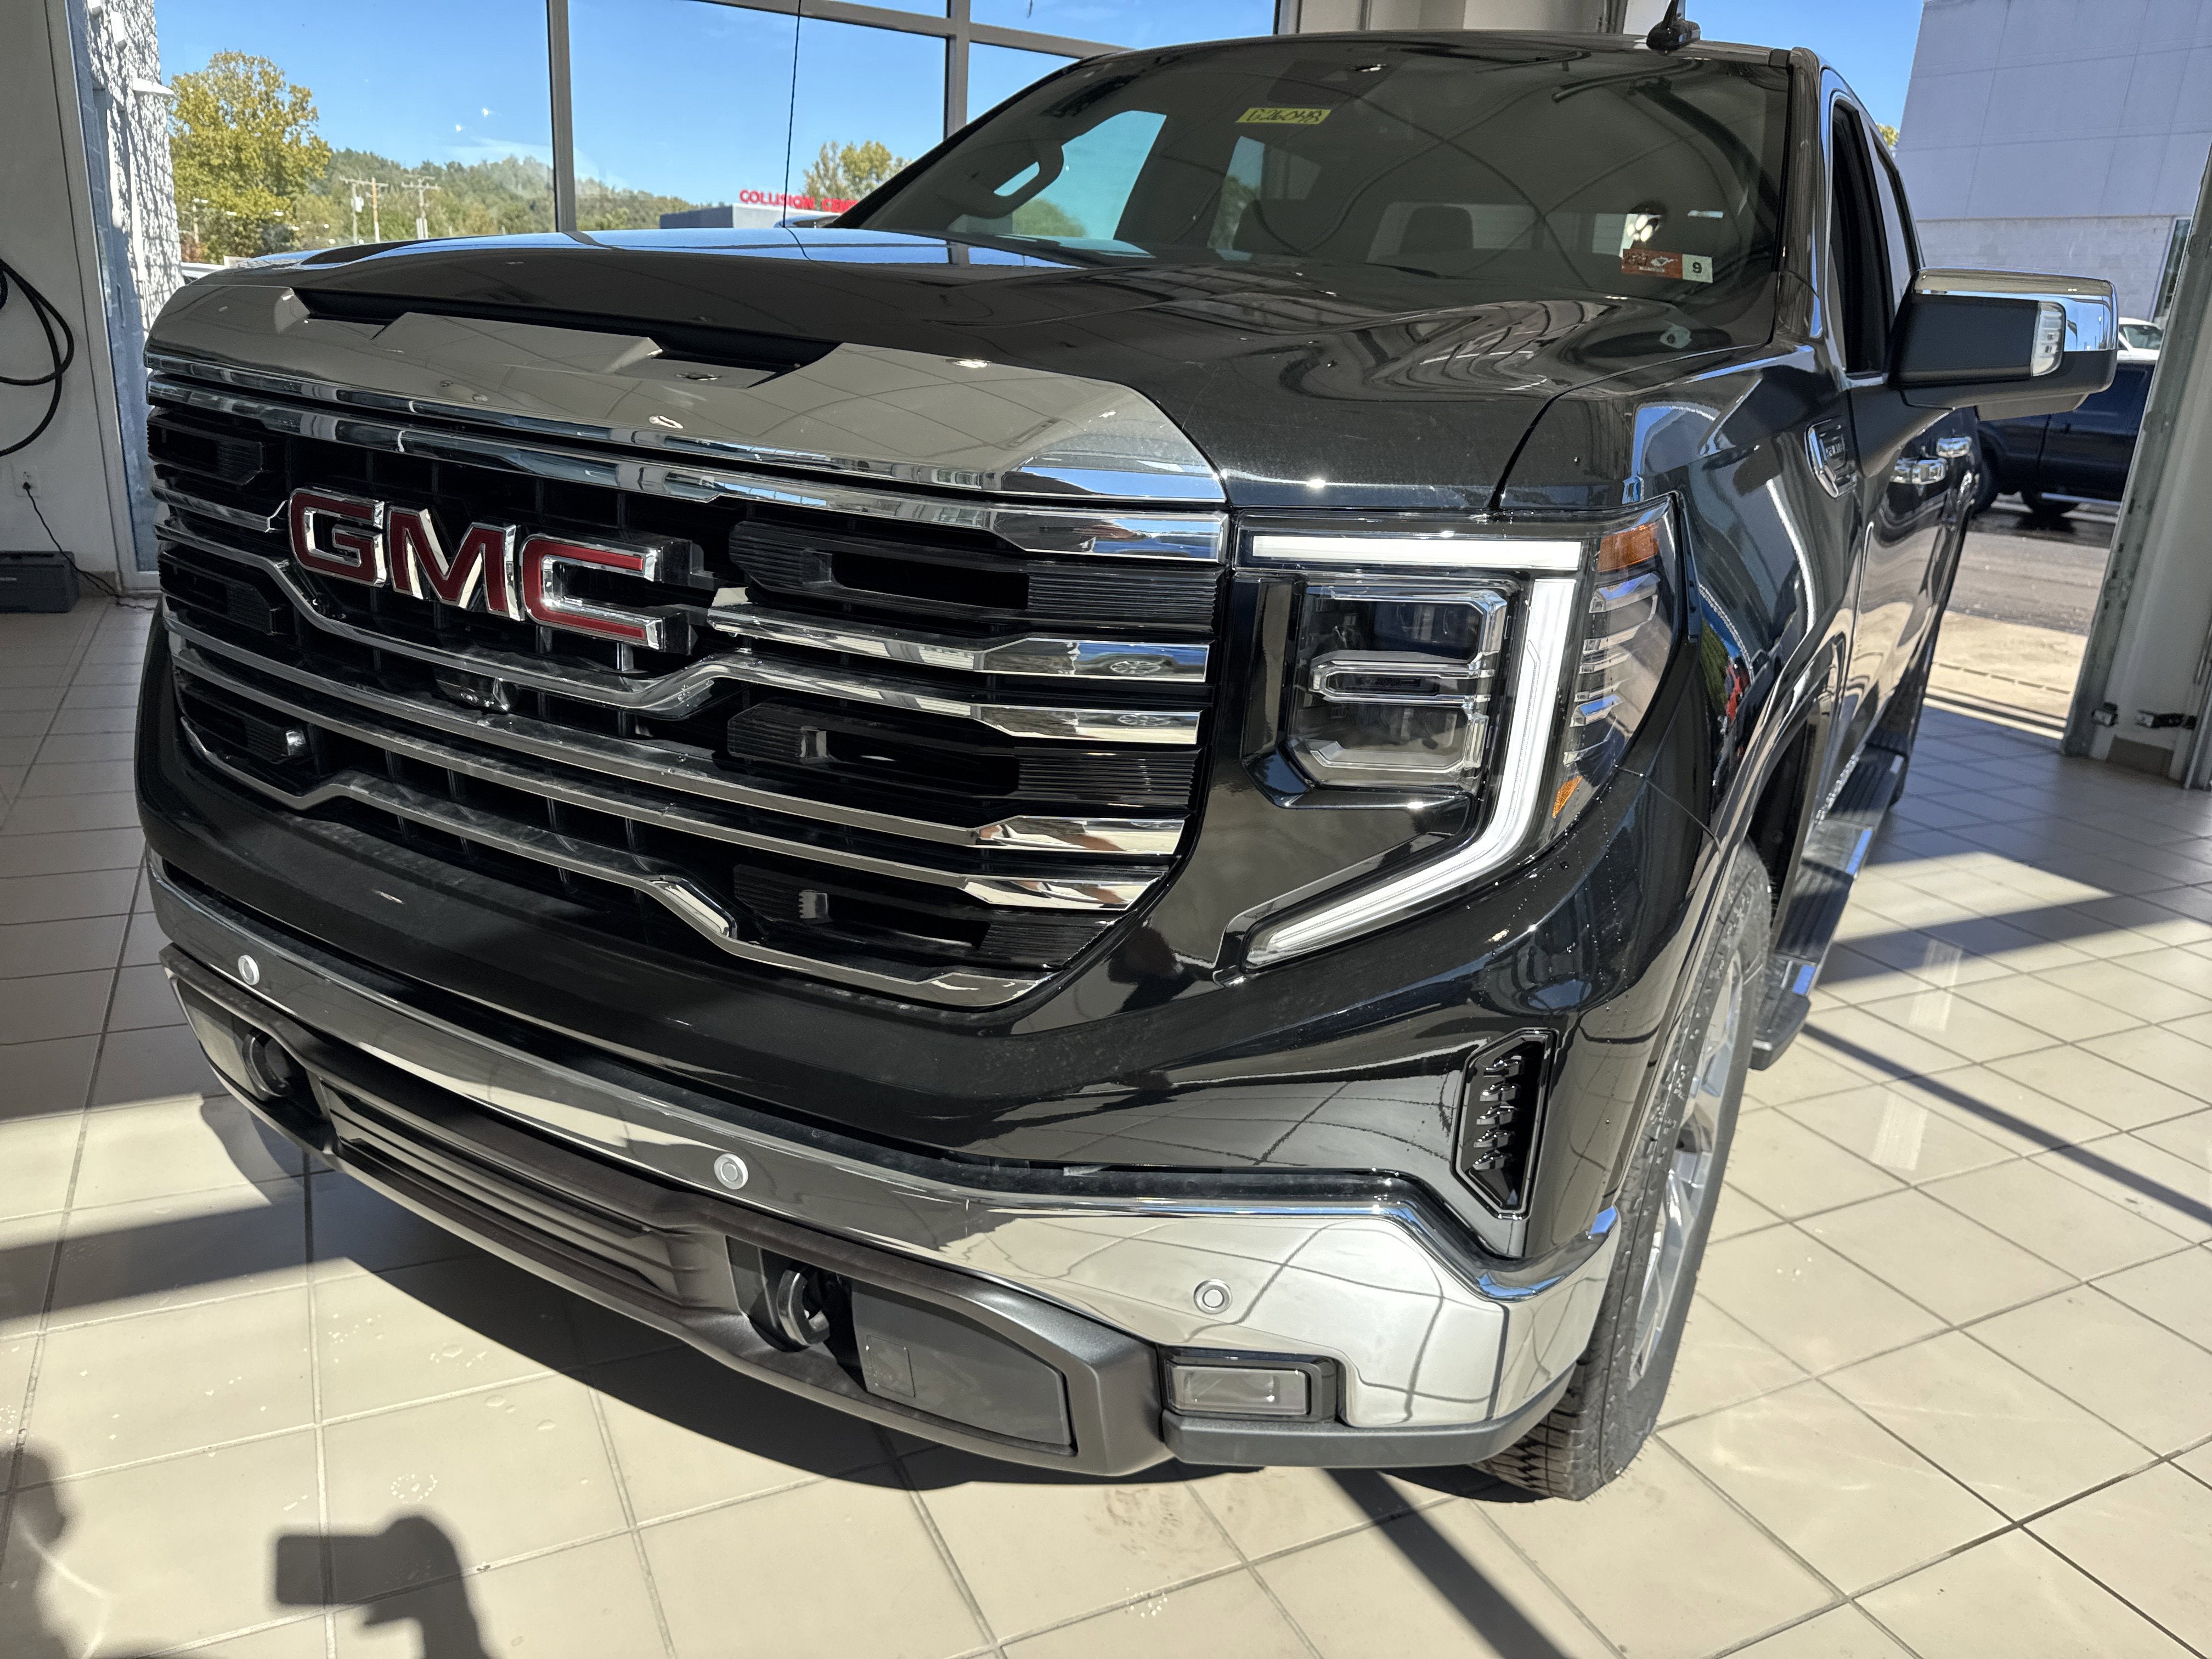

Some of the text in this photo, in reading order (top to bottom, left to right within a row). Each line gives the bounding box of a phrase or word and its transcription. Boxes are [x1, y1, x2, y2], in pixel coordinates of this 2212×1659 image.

[740, 189, 815, 210] COLLISION
[1692, 262, 1702, 273] 9
[289, 488, 664, 651] GMC
